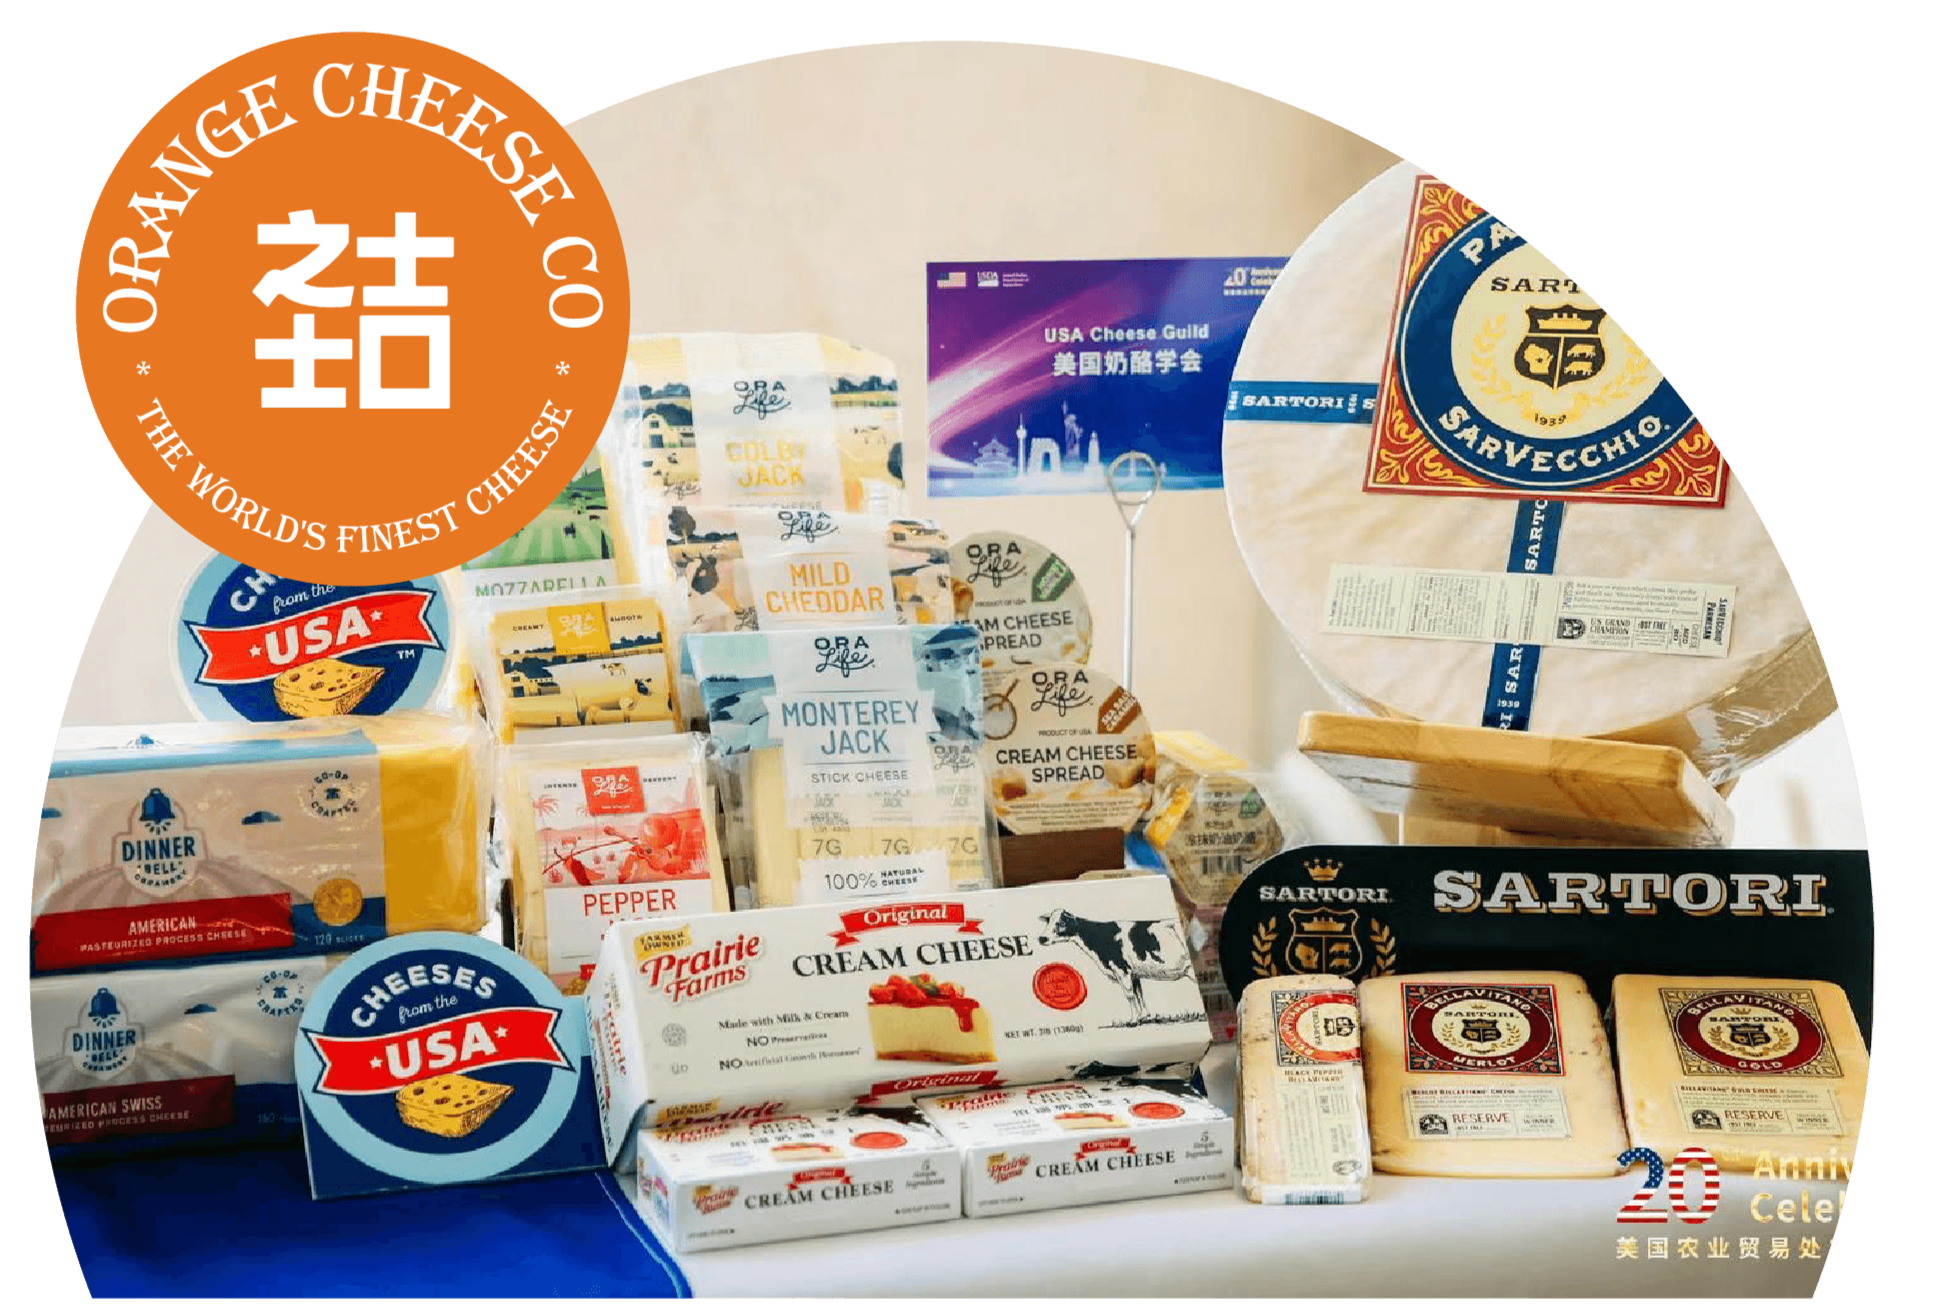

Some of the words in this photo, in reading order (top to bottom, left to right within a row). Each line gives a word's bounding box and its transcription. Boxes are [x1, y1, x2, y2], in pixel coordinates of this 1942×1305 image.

[1044, 328, 1084, 343] USA
[1090, 326, 1157, 342] Cheese
[1163, 324, 1210, 339] Guild
[1053, 349, 1203, 377] 美国奶酪学会
[733, 380, 786, 392] ORA
[733, 391, 792, 419] Life
[1242, 395, 1344, 409] SARTORI
[1534, 413, 1567, 426] 1939
[738, 464, 805, 488] JACK
[780, 517, 840, 543] Life
[966, 541, 1022, 558] ORA
[789, 562, 851, 588] MILD
[966, 555, 1027, 588] Life
[273, 593, 309, 615] from
[311, 583, 336, 599] the
[766, 587, 885, 614] CHEDDAR
[1003, 610, 1074, 630] CHEESE
[264, 605, 372, 666] USA
[814, 636, 870, 650] ORA
[396, 649, 415, 660] TM
[815, 648, 875, 678] Life
[1032, 669, 1088, 686] ORA
[1504, 643, 1525, 693] SAR
[1031, 682, 1094, 717] Life
[1497, 699, 1520, 709] 1939
[782, 700, 920, 727] MONTEREY
[821, 729, 892, 755] JACK
[1038, 730, 1068, 738] PRODUCT
[1069, 729, 1078, 737] OF
[934, 745, 973, 754] ORA
[996, 747, 1062, 765] CREAM
[1066, 744, 1138, 761] CHEESE
[592, 774, 629, 784] ORA
[811, 772, 851, 784] STICK
[855, 770, 909, 782] CHEESE
[1031, 766, 1105, 783] SPREAD
[122, 836, 196, 862] DINNER
[812, 839, 842, 856] 7G
[881, 839, 911, 855] 7G
[947, 837, 978, 854] 7G
[824, 871, 878, 890] 100%
[880, 868, 924, 878] NATURAL
[881, 877, 918, 887] CHEESE
[583, 889, 677, 917] PEPPER
[1258, 886, 1390, 903] SARTORI
[1432, 870, 1828, 917] SARTORI
[862, 903, 949, 926] Original
[128, 917, 197, 936] AMERICAN
[79, 937, 152, 952] PASTEURIZED
[156, 933, 203, 946] PROCESS
[206, 930, 247, 941] CHEESE
[639, 933, 762, 987] Prairie
[792, 946, 908, 978] CREAM
[916, 935, 1034, 966] CHEESE
[263, 970, 298, 984] CO-OP
[664, 965, 747, 1002] Farms
[352, 963, 497, 1028] CHEESES
[1424, 989, 1532, 1011] BELLAVITANO
[1687, 994, 1794, 1016] BELLAVITANO
[399, 1001, 434, 1024] from
[434, 994, 459, 1009] the
[718, 1020, 748, 1030] Made
[750, 1016, 774, 1027] with
[776, 1013, 801, 1025] Milk
[803, 1012, 812, 1021] &
[814, 1010, 850, 1020] Cream
[72, 1029, 137, 1052] DINNER
[746, 1035, 769, 1048] NO
[1004, 1030, 1020, 1039] NET
[385, 1021, 499, 1080] USA
[719, 1057, 743, 1071] NO
[1453, 1055, 1516, 1067] MERLOT
[1737, 1060, 1783, 1070] GOLD
[893, 1072, 980, 1092] Original
[48, 1100, 118, 1121] AMERICAN
[121, 1096, 162, 1112] SWISS
[1452, 1112, 1512, 1124] RESERVE
[1724, 1109, 1785, 1120] RESERVE
[98, 1114, 146, 1128] PROCESS
[149, 1110, 190, 1123] CHEESE
[1035, 1158, 1100, 1179] CREAM
[1107, 1150, 1176, 1170] CHEESE
[744, 1190, 813, 1210] CREAM
[820, 1179, 894, 1201] CHEESE
